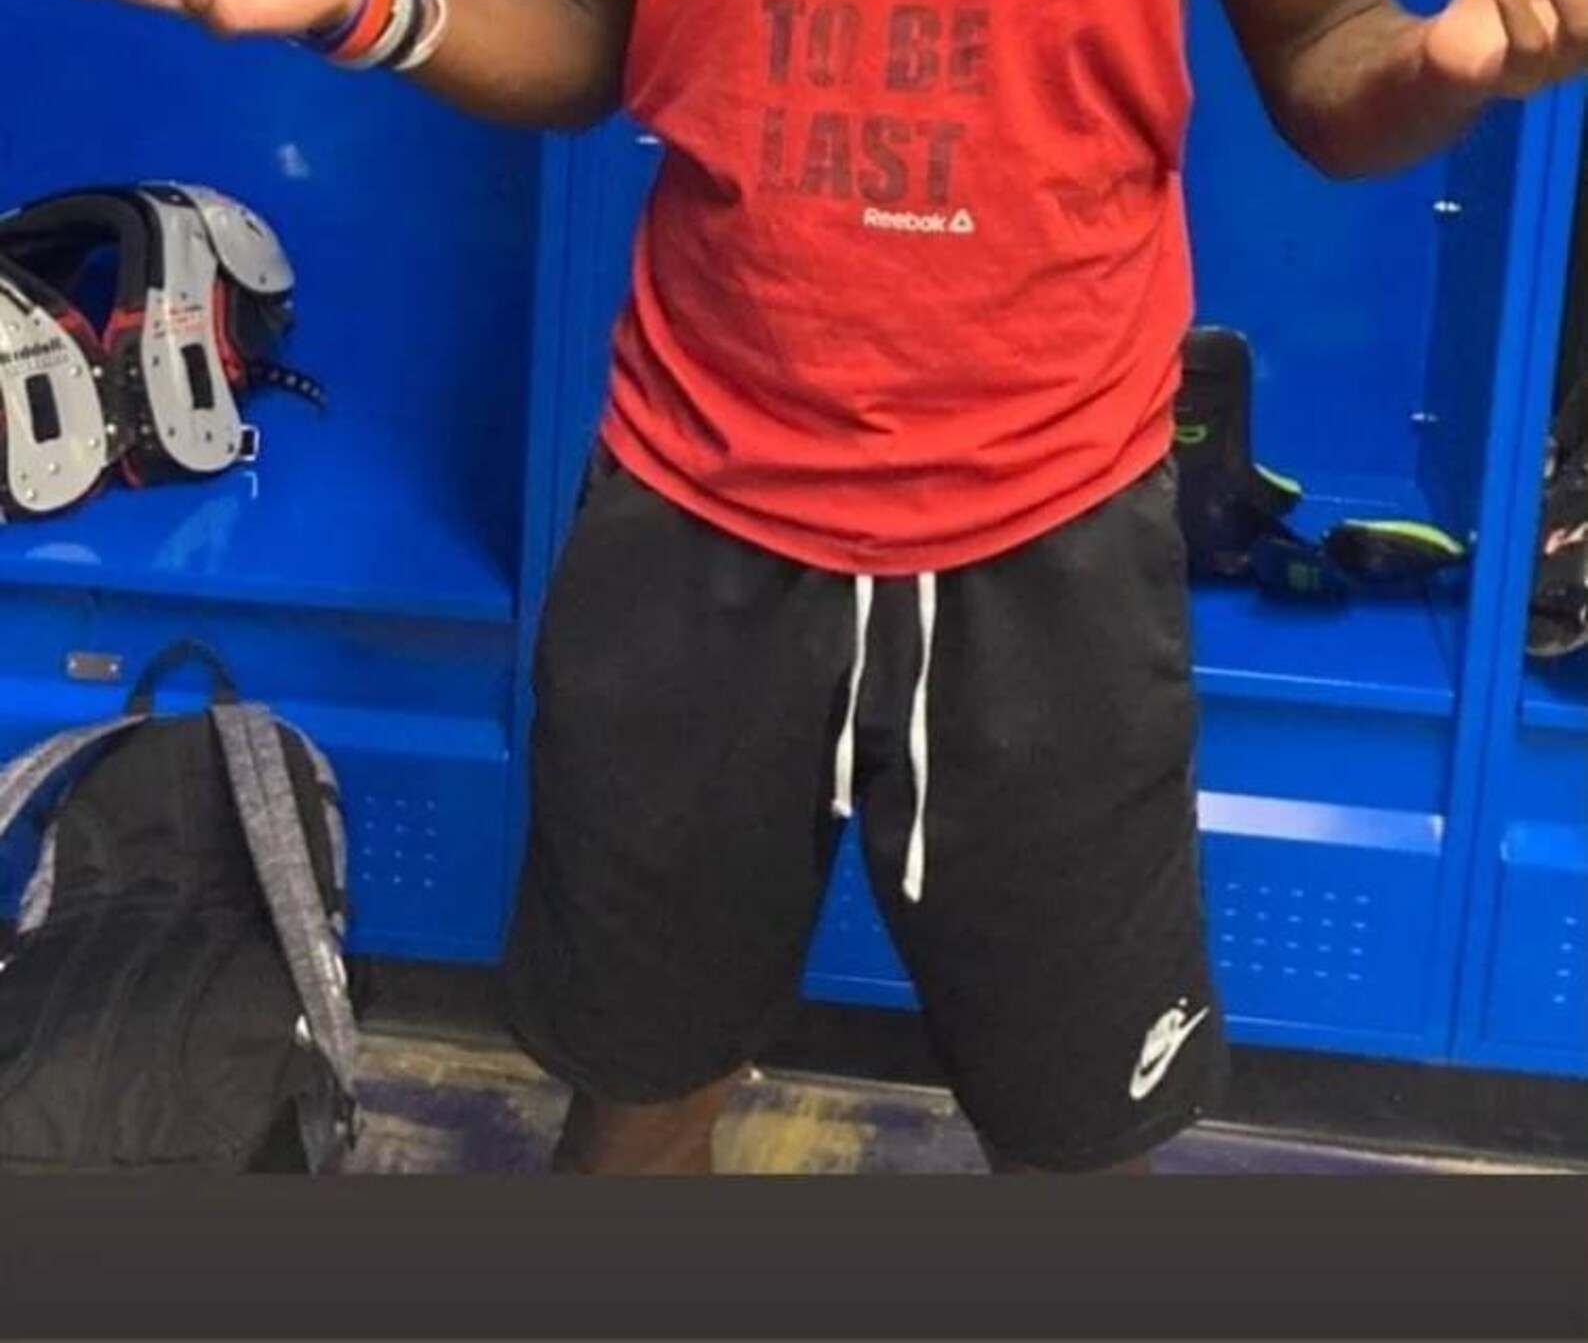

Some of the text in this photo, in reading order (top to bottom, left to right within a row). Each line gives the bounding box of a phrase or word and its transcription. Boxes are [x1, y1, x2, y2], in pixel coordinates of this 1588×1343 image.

[885, 3, 992, 96] BE
[757, 105, 965, 205] LAST
[863, 207, 947, 233] Reebok
